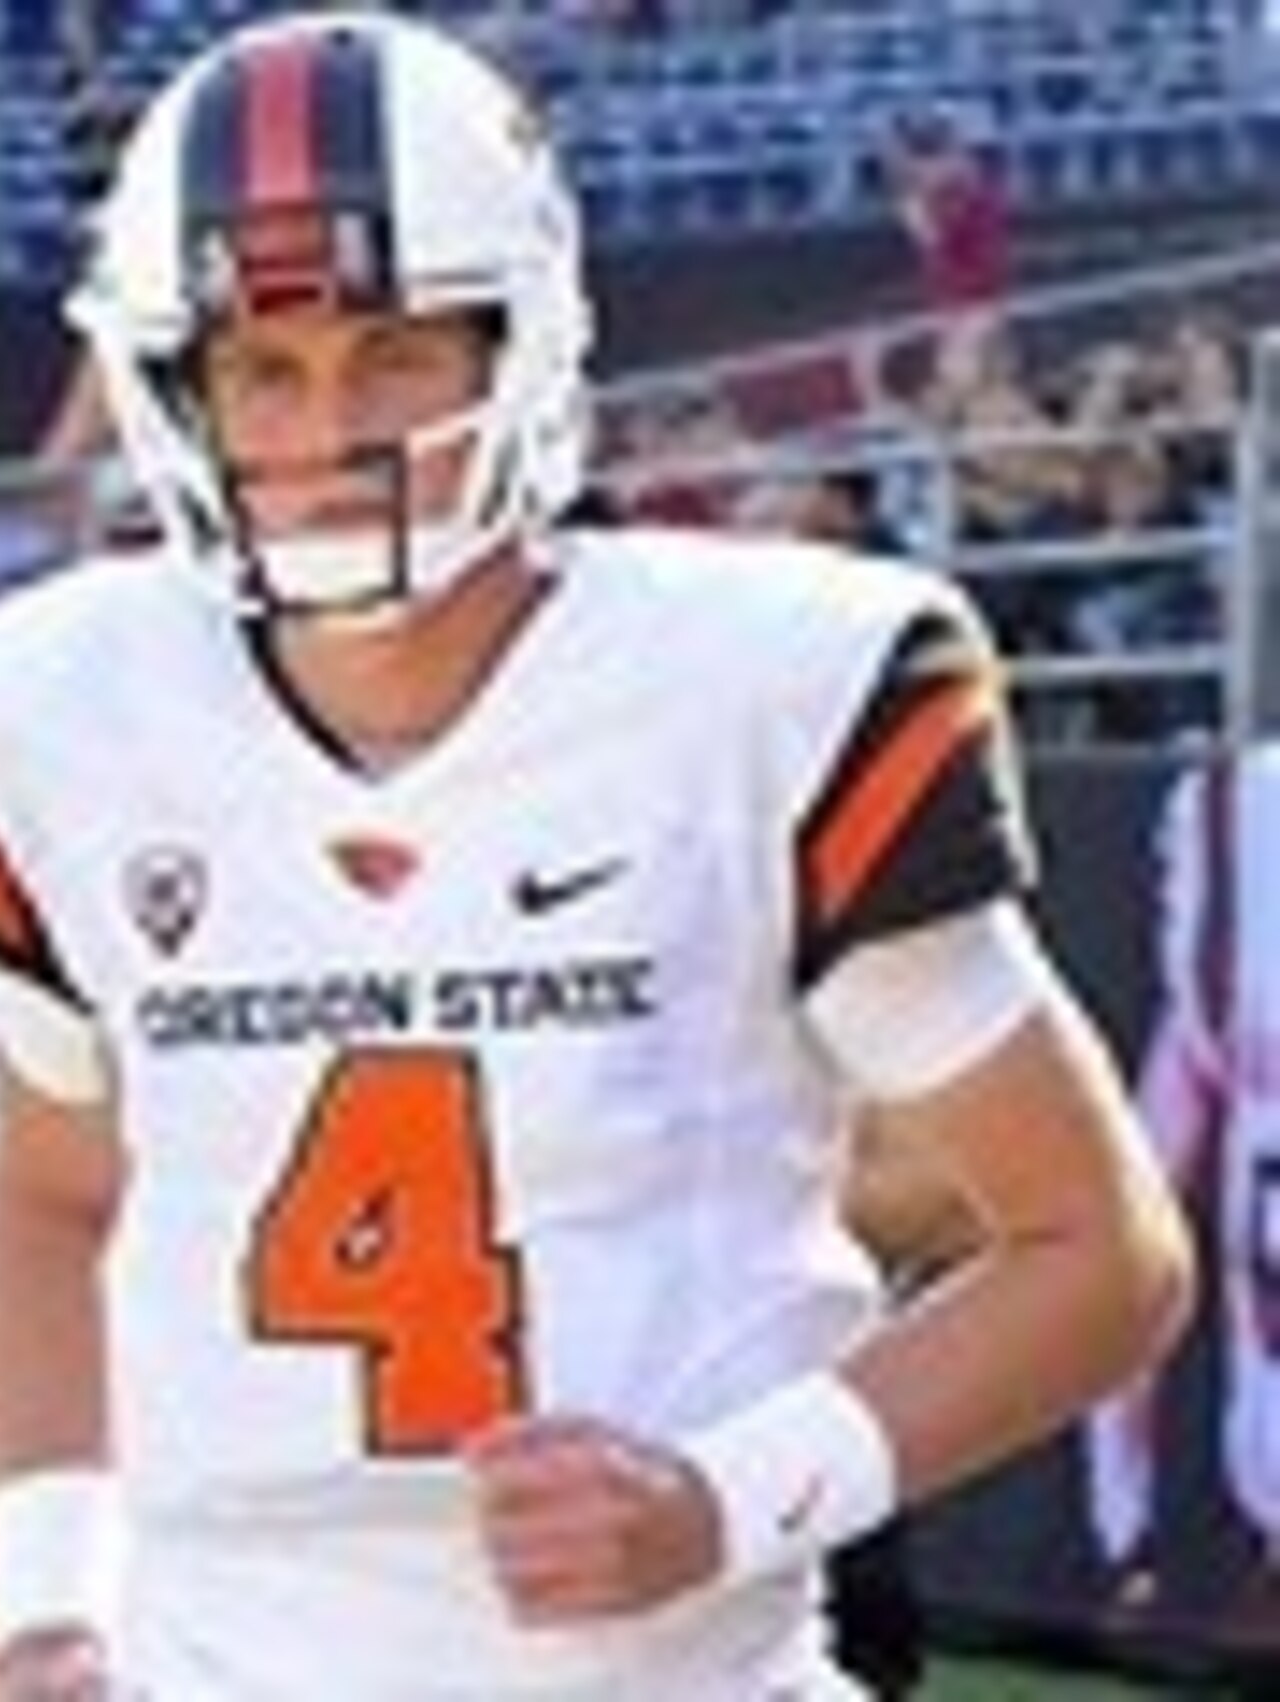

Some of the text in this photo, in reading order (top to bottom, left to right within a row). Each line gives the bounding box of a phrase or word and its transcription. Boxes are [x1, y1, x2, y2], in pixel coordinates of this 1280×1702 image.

[136, 959, 654, 1046] OREGON STATE
[243, 1048, 532, 1456] 4
